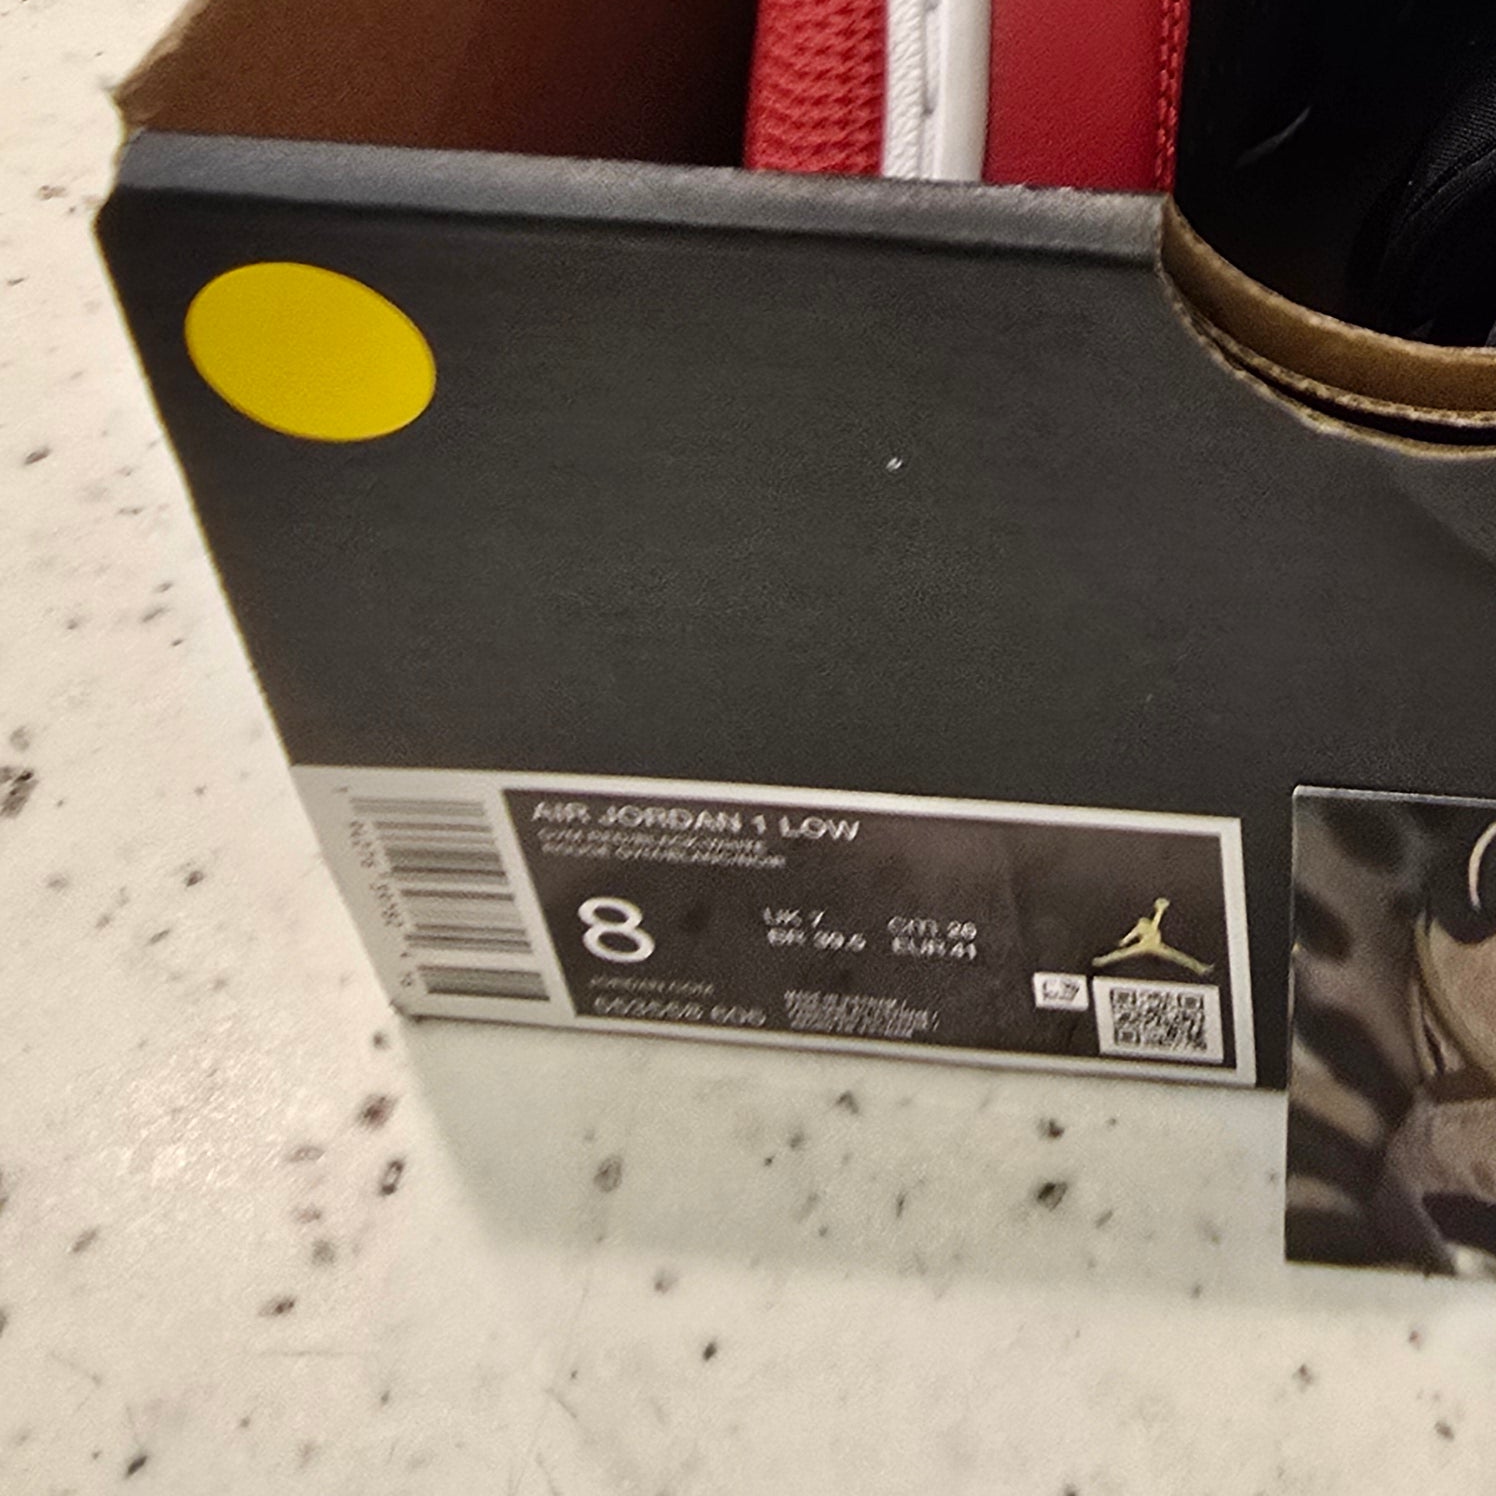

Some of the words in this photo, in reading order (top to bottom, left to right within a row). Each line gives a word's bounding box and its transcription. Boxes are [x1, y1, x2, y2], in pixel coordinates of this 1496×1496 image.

[531, 801, 590, 824] AIR
[599, 804, 742, 834] JORDAN
[752, 814, 767, 836] 1
[778, 815, 860, 840] LOW
[578, 897, 655, 963] 8
